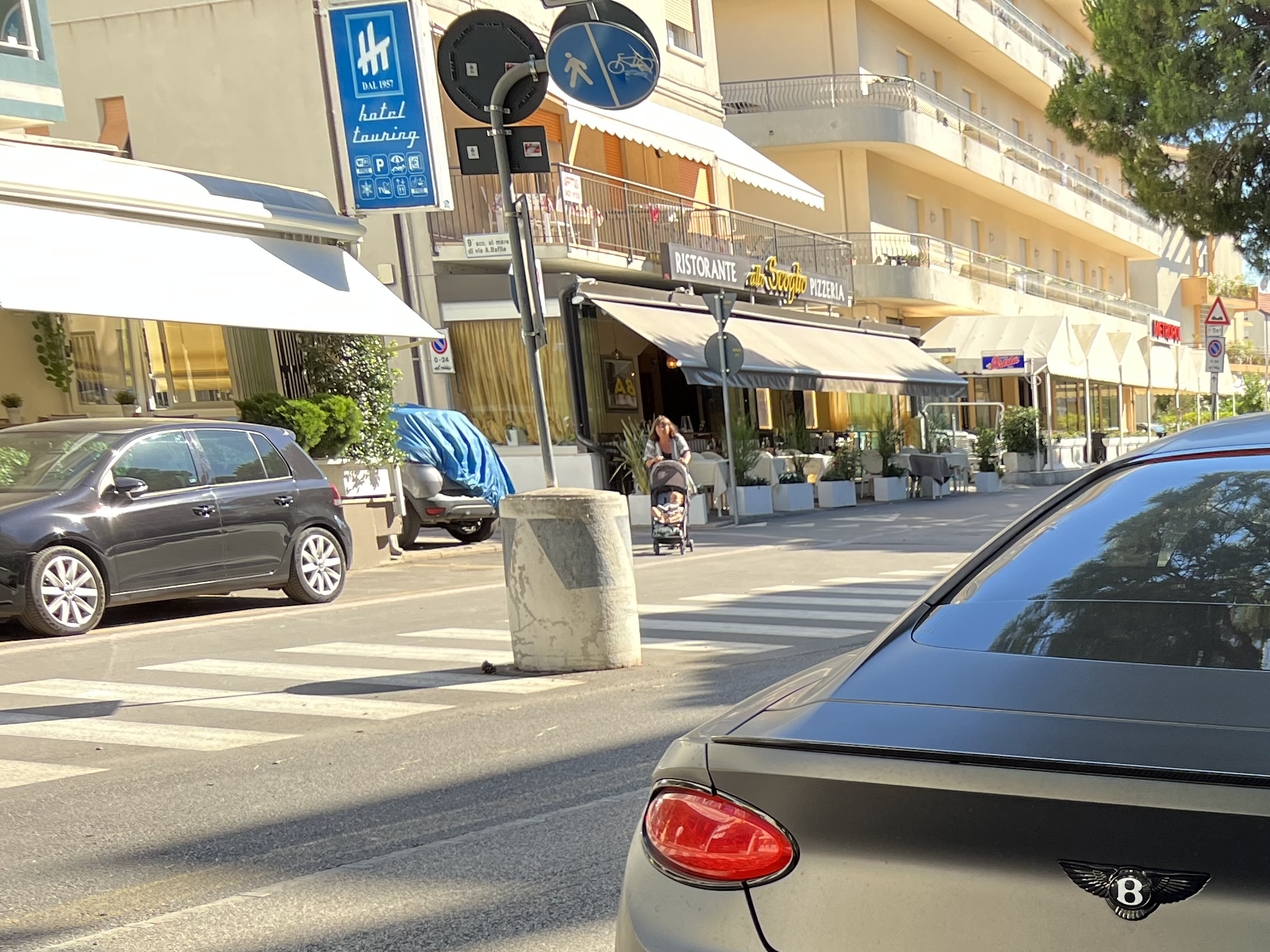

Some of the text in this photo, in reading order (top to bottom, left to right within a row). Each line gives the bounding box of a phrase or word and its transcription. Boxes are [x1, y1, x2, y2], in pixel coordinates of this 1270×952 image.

[362, 79, 394, 90] DAL 1957
[359, 100, 406, 122] hotel
[352, 126, 420, 149] touring
[675, 251, 737, 283] RISTORANTE
[809, 277, 845, 302] PIZZERIA
